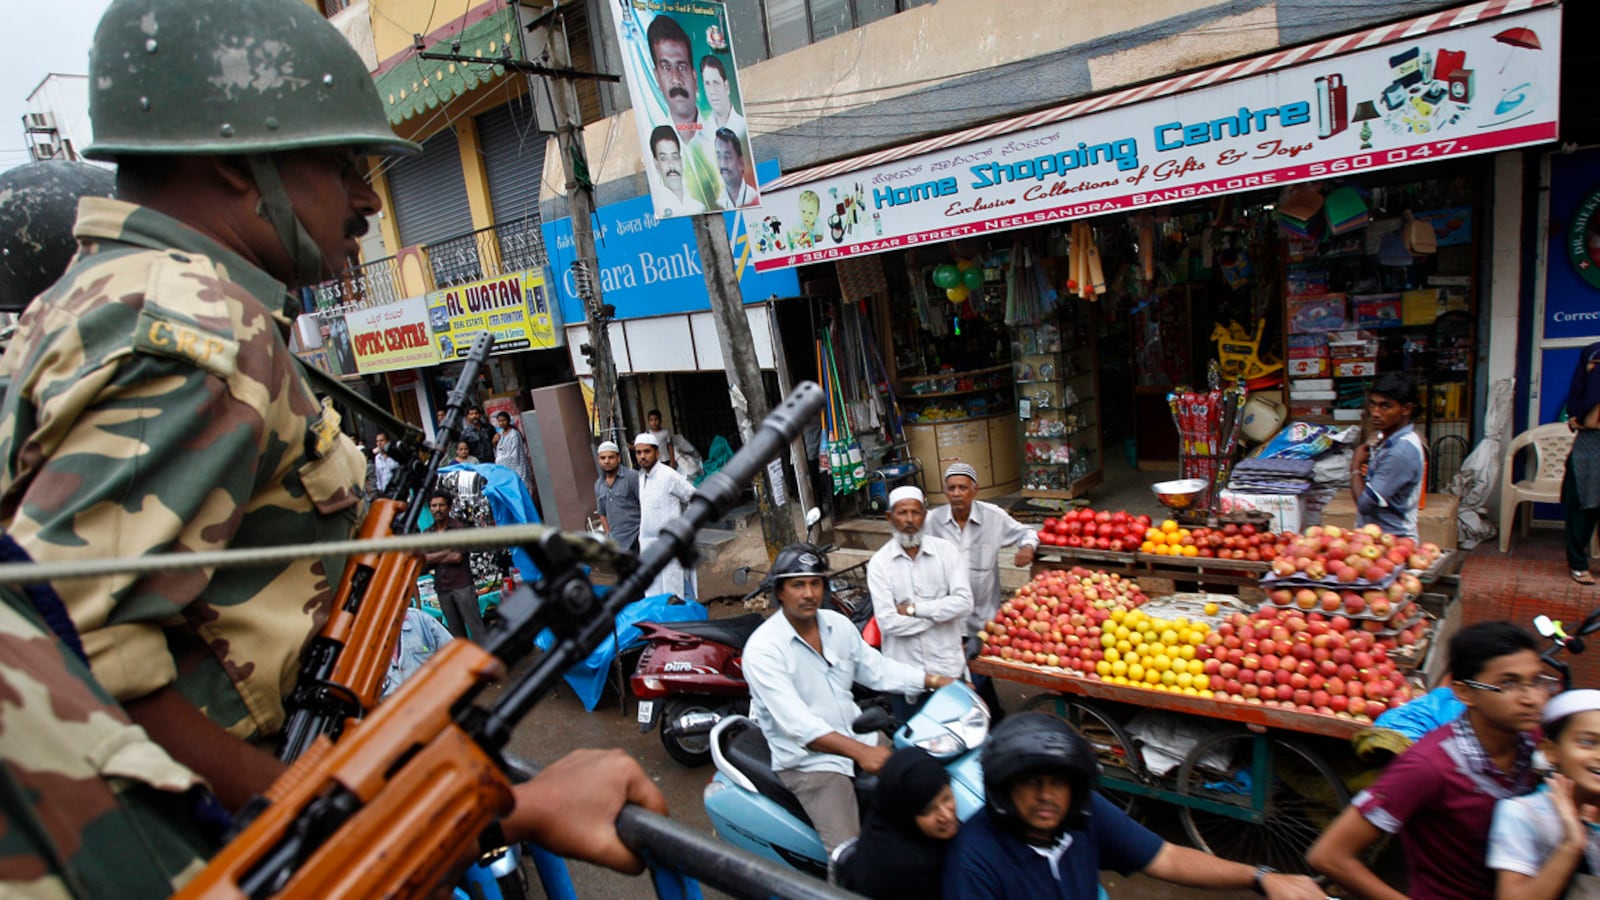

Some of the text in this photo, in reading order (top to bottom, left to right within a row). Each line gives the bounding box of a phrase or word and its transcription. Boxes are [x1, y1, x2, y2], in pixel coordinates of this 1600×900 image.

[872, 101, 1311, 210] Home Shopping Centre
[944, 139, 1314, 217] Exclusive Collections of Gifts & Toys
[787, 255, 797, 266] #
[850, 236, 900, 254] BAZAR
[1132, 173, 1277, 206] BANGALORE
[1309, 156, 1372, 176] 560
[563, 244, 703, 299] Cara Bank
[446, 290, 466, 318] AL
[465, 277, 523, 313] WATAN
[148, 320, 225, 362] CRP
[354, 330, 385, 357] OPTIC
[384, 321, 429, 352] CENTRE
[663, 662, 692, 673] Duro
